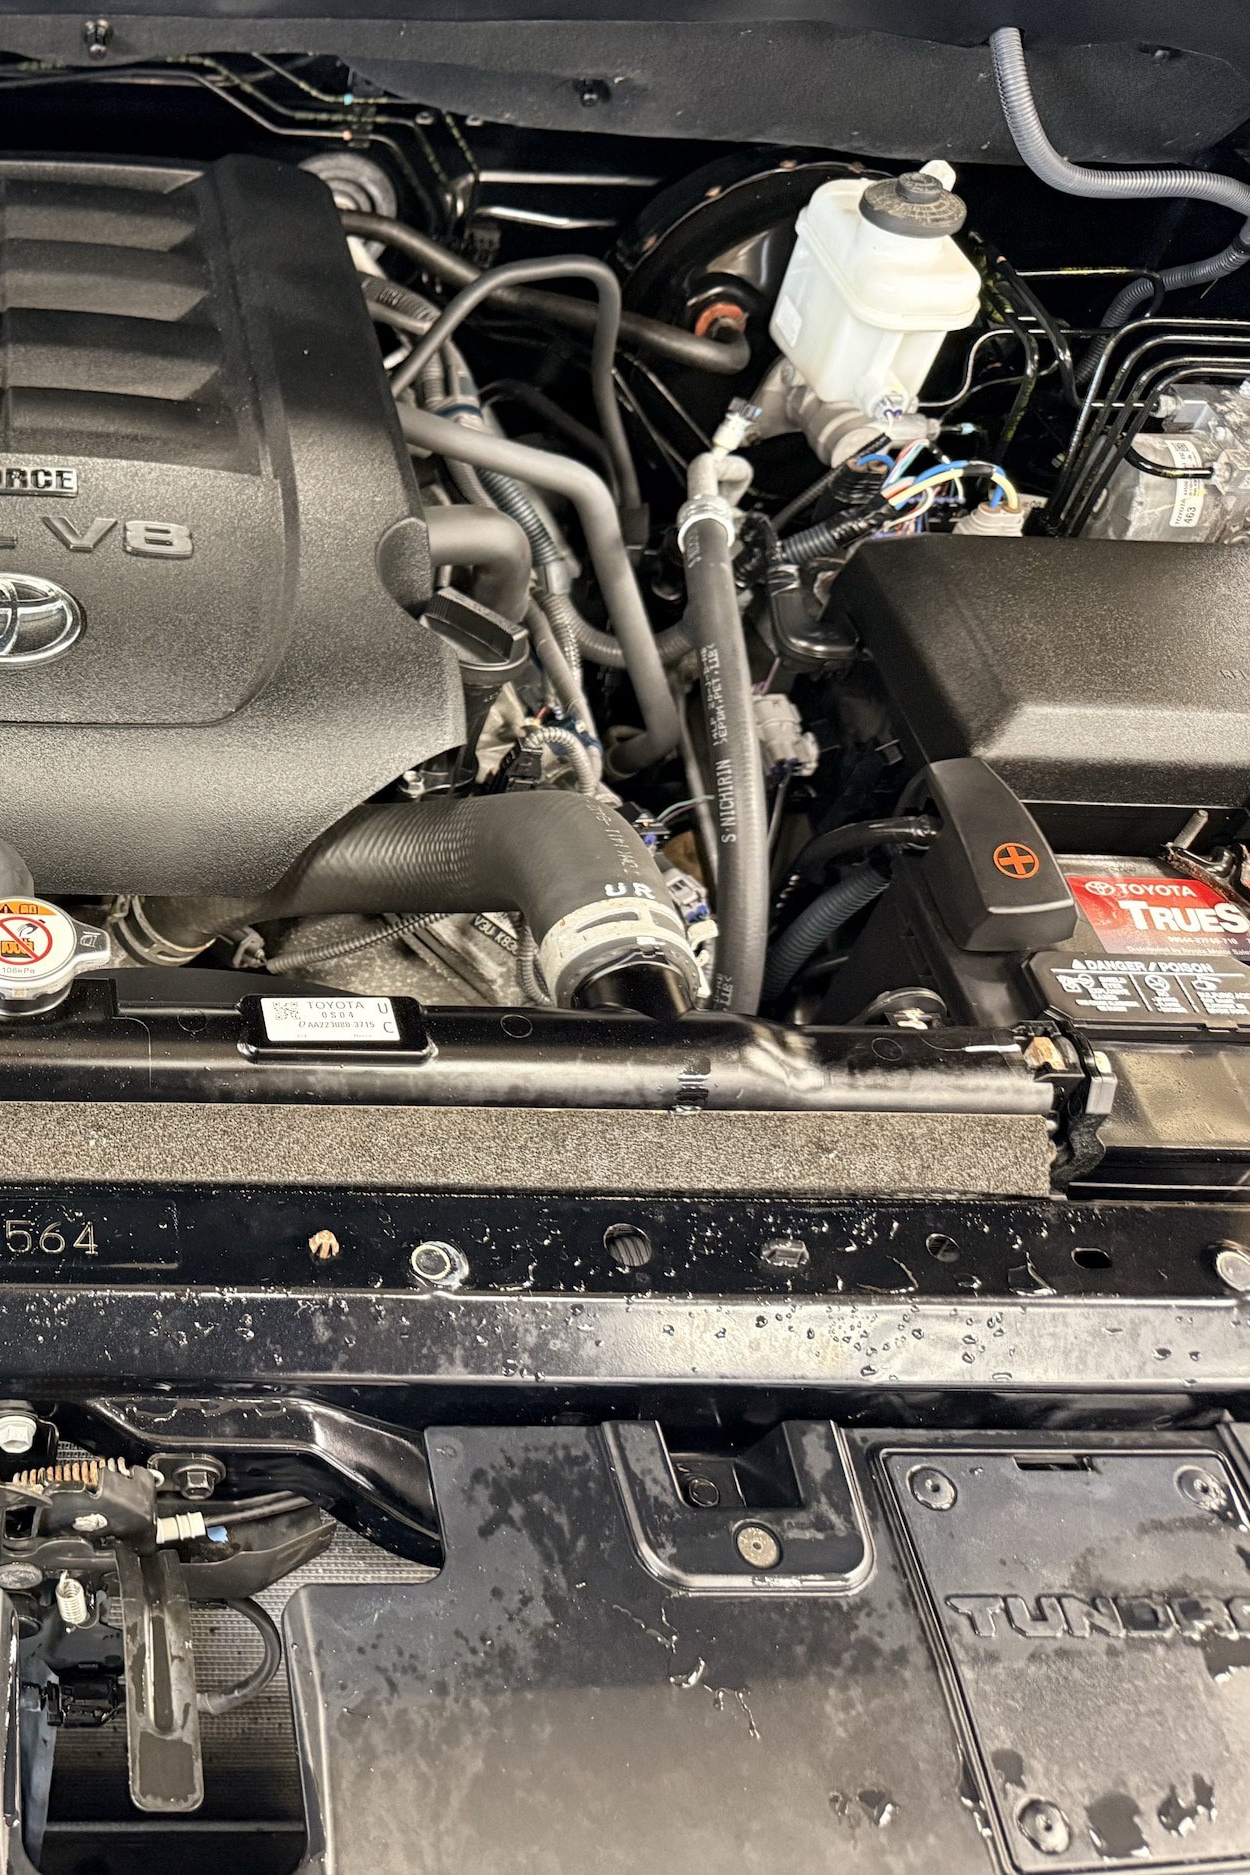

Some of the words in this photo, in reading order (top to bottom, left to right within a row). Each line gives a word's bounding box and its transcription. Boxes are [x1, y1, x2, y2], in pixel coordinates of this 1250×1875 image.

[1183, 506, 1197, 524] 463
[42, 515, 194, 558] V8
[1115, 883, 1198, 898] TOYOTA
[1085, 960, 1146, 972] DANGER
[1158, 962, 1215, 974] POISON
[307, 1001, 365, 1009] TOYOTA
[377, 1002, 389, 1014] U
[383, 1022, 395, 1034] C
